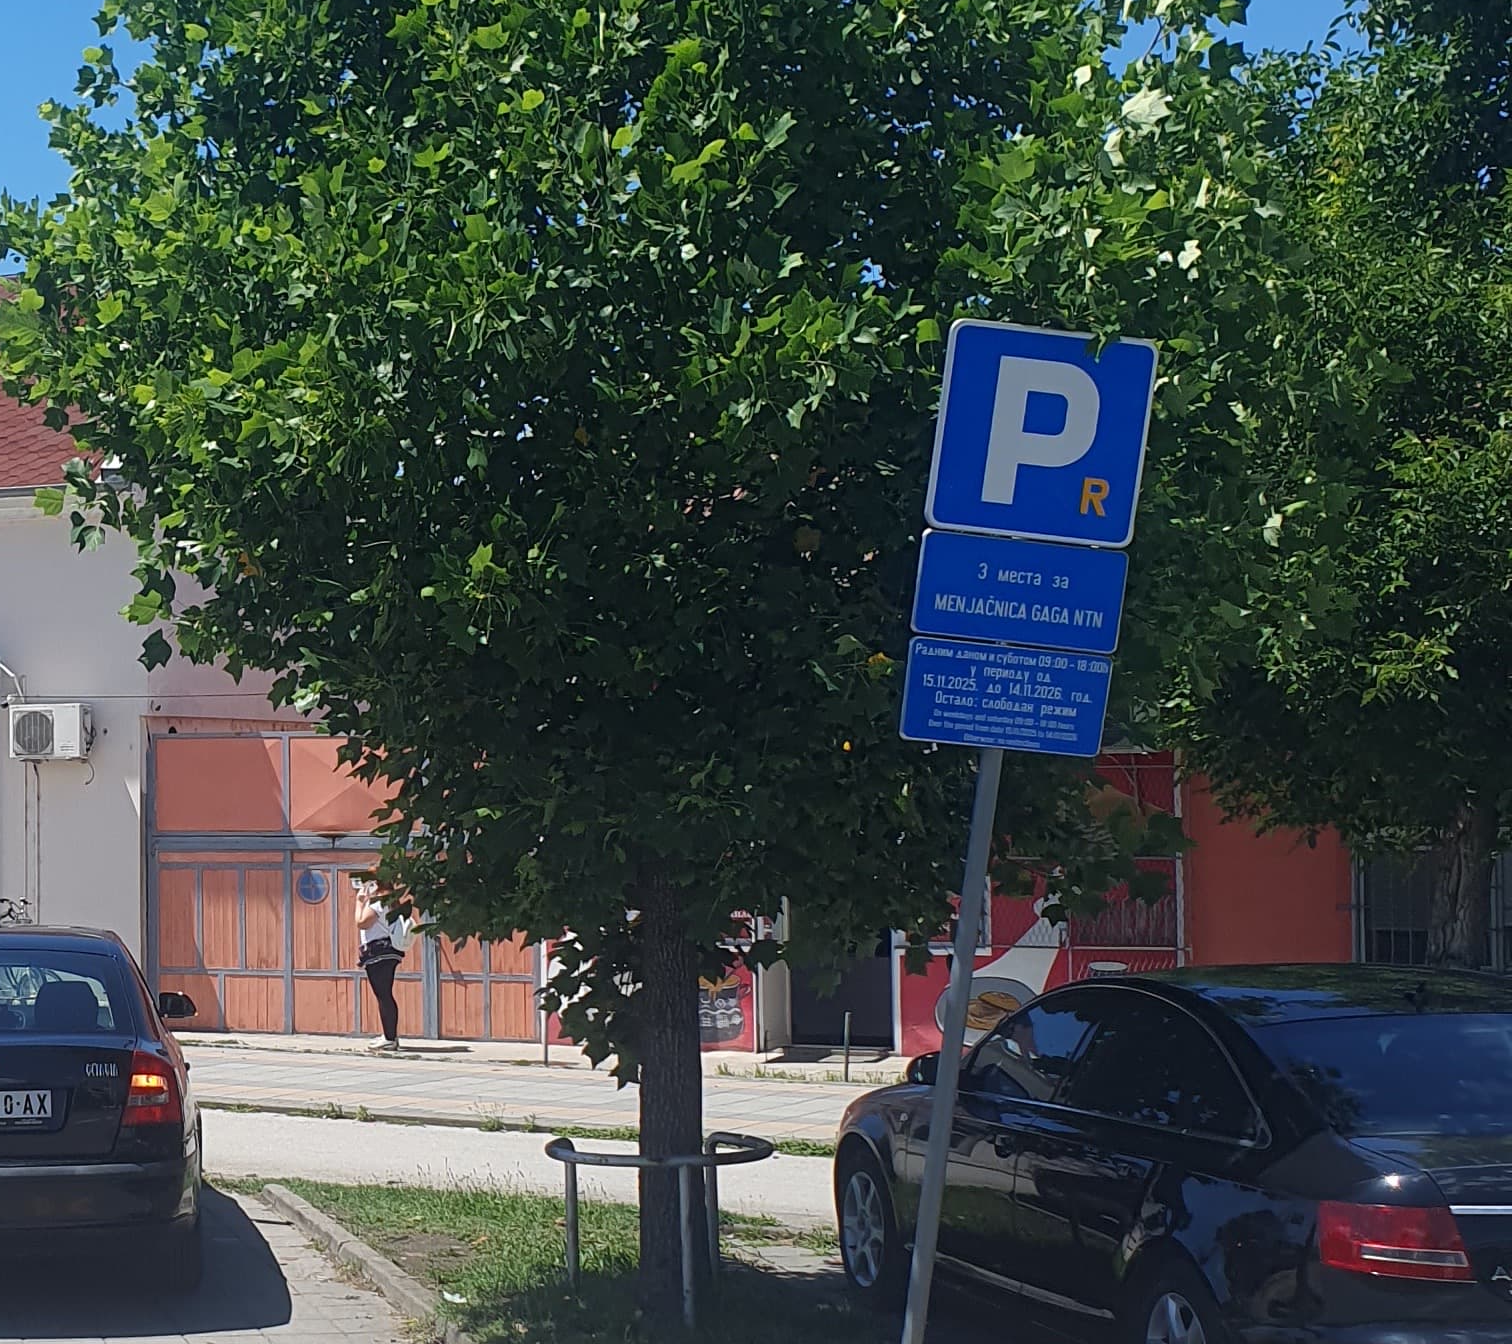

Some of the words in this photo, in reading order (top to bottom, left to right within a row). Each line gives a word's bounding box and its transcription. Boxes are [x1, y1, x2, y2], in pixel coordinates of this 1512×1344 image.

[981, 355, 1100, 505] P
[1080, 477, 1110, 517] R
[977, 562, 989, 580] 3
[997, 568, 1042, 586] места
[1052, 575, 1069, 589] за
[934, 593, 1027, 620] MENJAČNICA
[1031, 604, 1069, 625] GAGA
[1073, 608, 1104, 629] NTN
[984, 666, 1029, 684] периоду
[1036, 671, 1051, 683] од
[986, 682, 1002, 694] до
[935, 690, 978, 708] Остало:
[1040, 703, 1077, 718] режим
